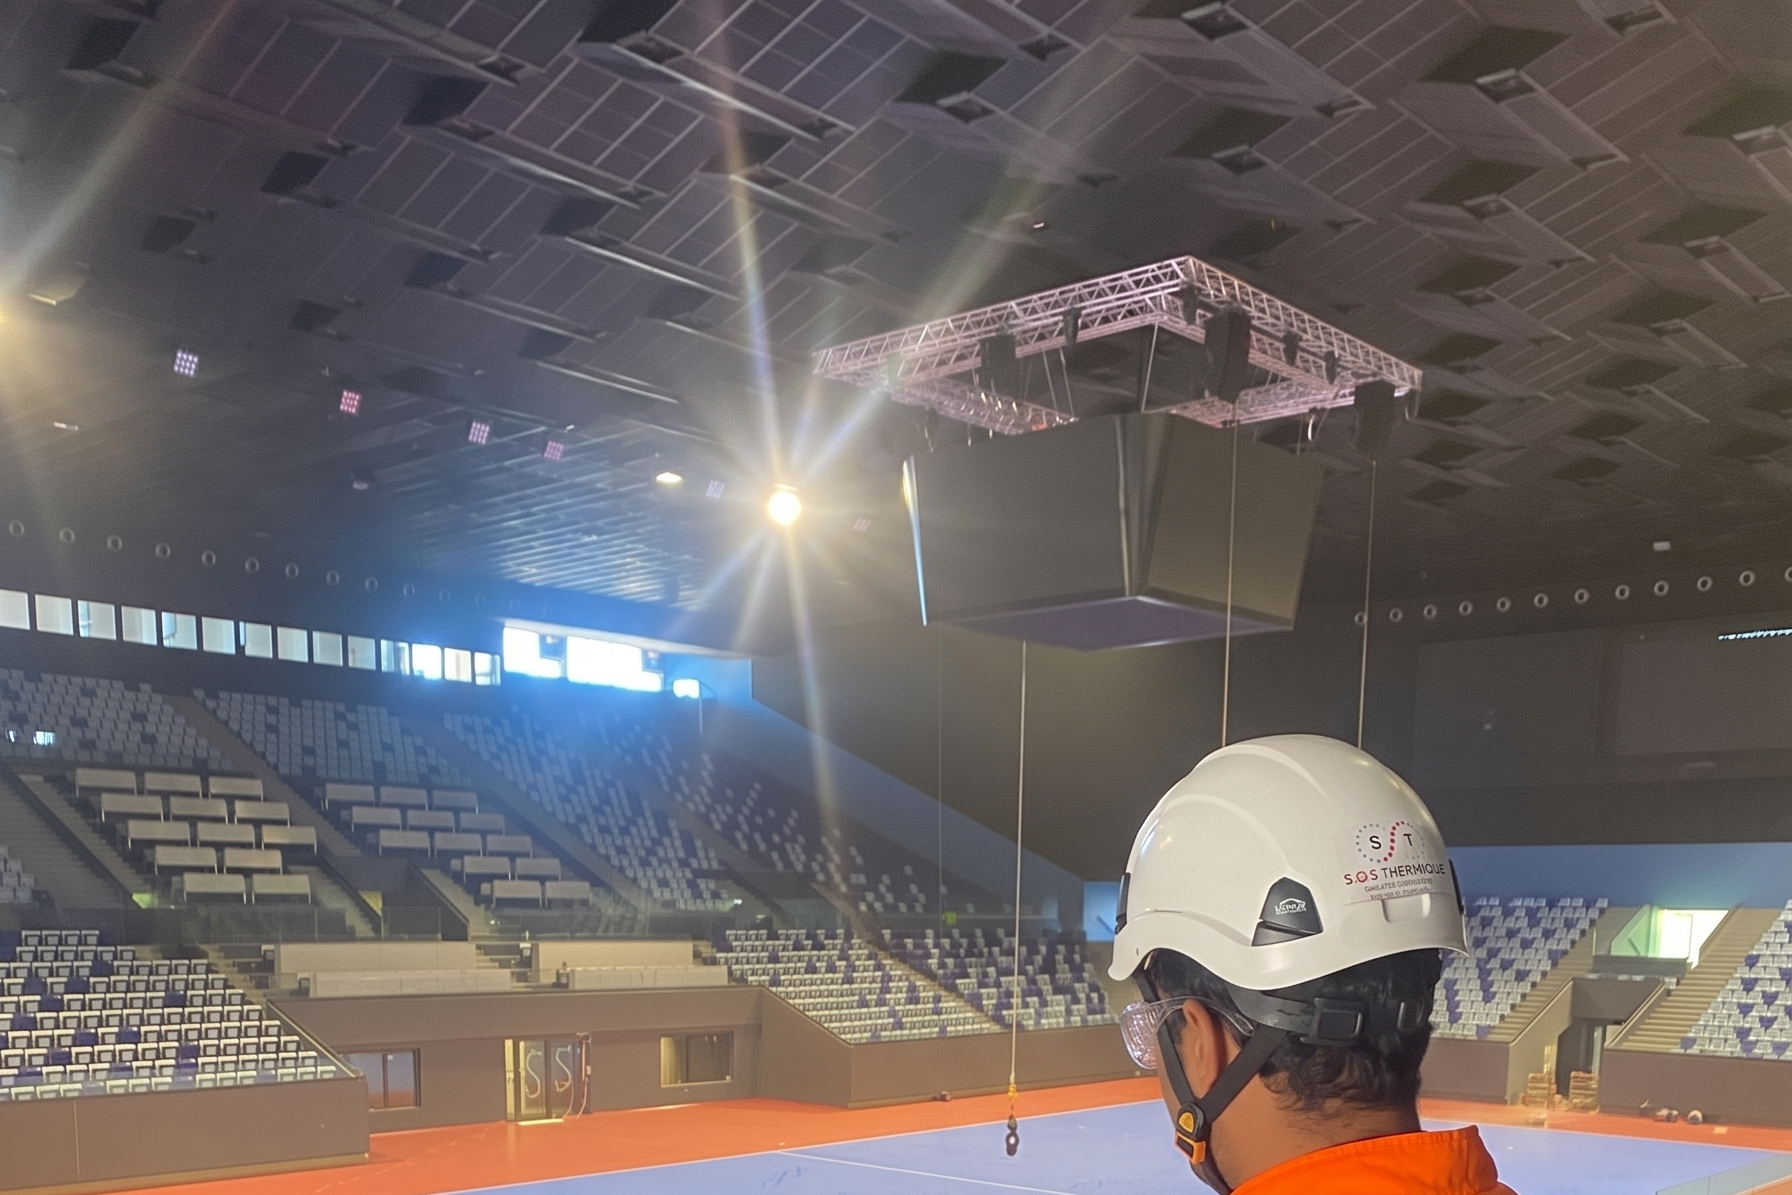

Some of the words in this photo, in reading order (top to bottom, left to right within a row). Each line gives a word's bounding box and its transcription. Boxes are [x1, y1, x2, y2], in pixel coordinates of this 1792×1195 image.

[1369, 835, 1382, 850] S
[1403, 833, 1413, 847] T
[1381, 863, 1446, 879] THERMIQUE
